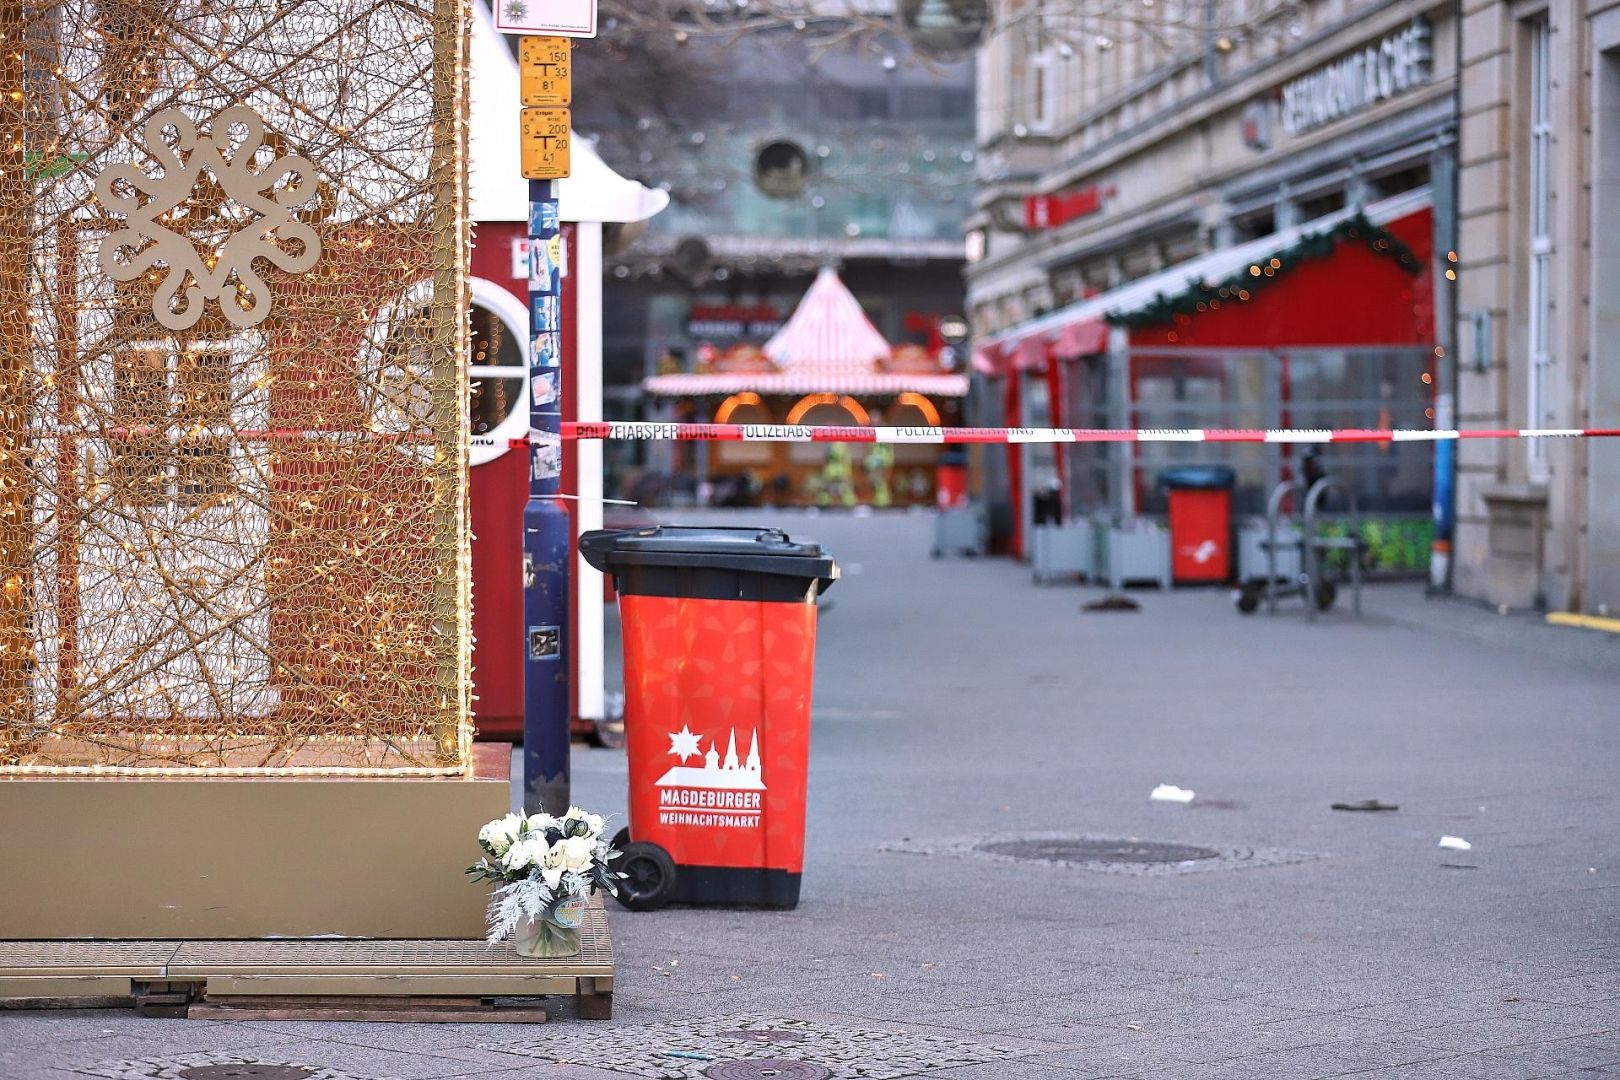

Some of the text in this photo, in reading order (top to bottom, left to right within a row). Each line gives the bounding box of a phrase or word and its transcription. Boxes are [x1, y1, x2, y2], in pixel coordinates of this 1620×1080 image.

[523, 52, 567, 62] S 150
[524, 124, 567, 134] S 200
[660, 789, 761, 808] MAGDEBURGER
[660, 812, 761, 827] WEIHNACHTSMARKT
